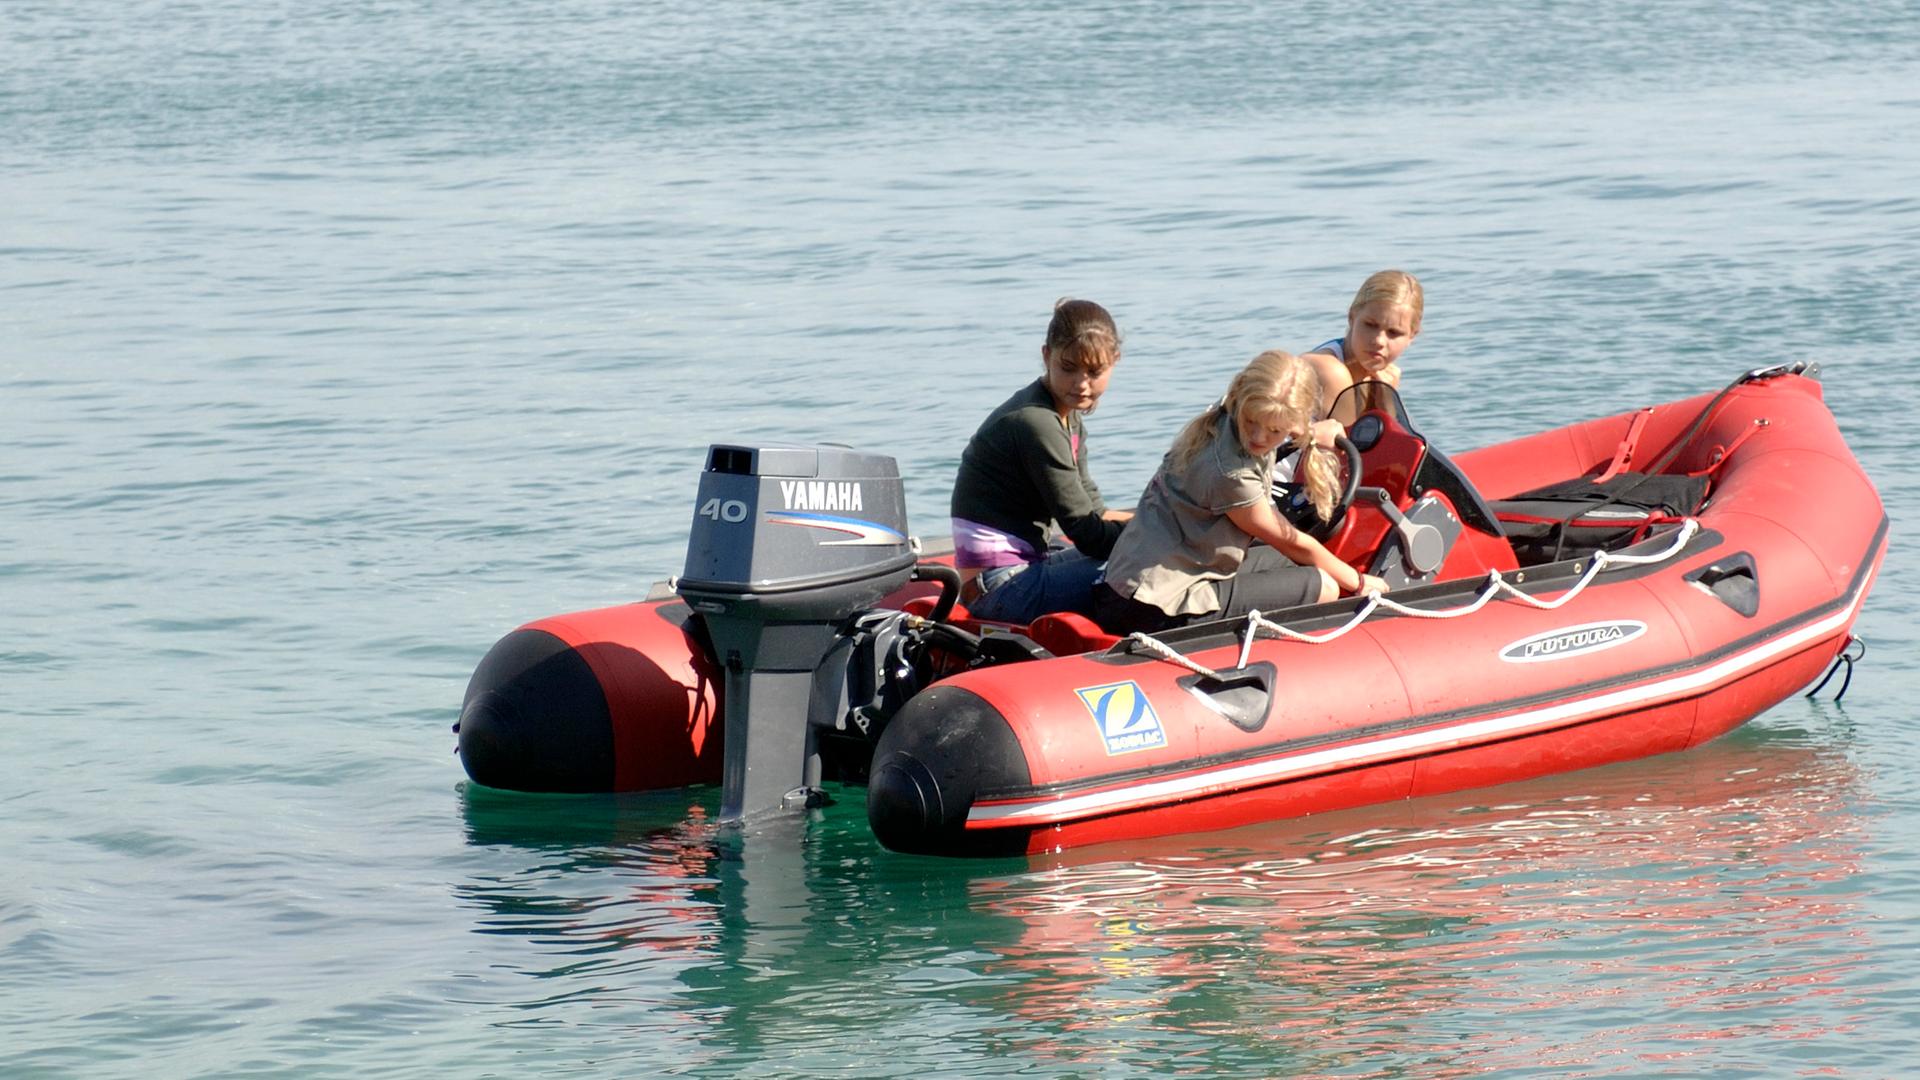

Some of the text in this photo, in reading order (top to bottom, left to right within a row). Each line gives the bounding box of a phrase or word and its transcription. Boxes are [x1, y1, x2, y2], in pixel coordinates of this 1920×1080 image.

[700, 498, 748, 523] 40
[780, 480, 863, 512] YAMAHA
[1525, 625, 1624, 658] FUTURA
